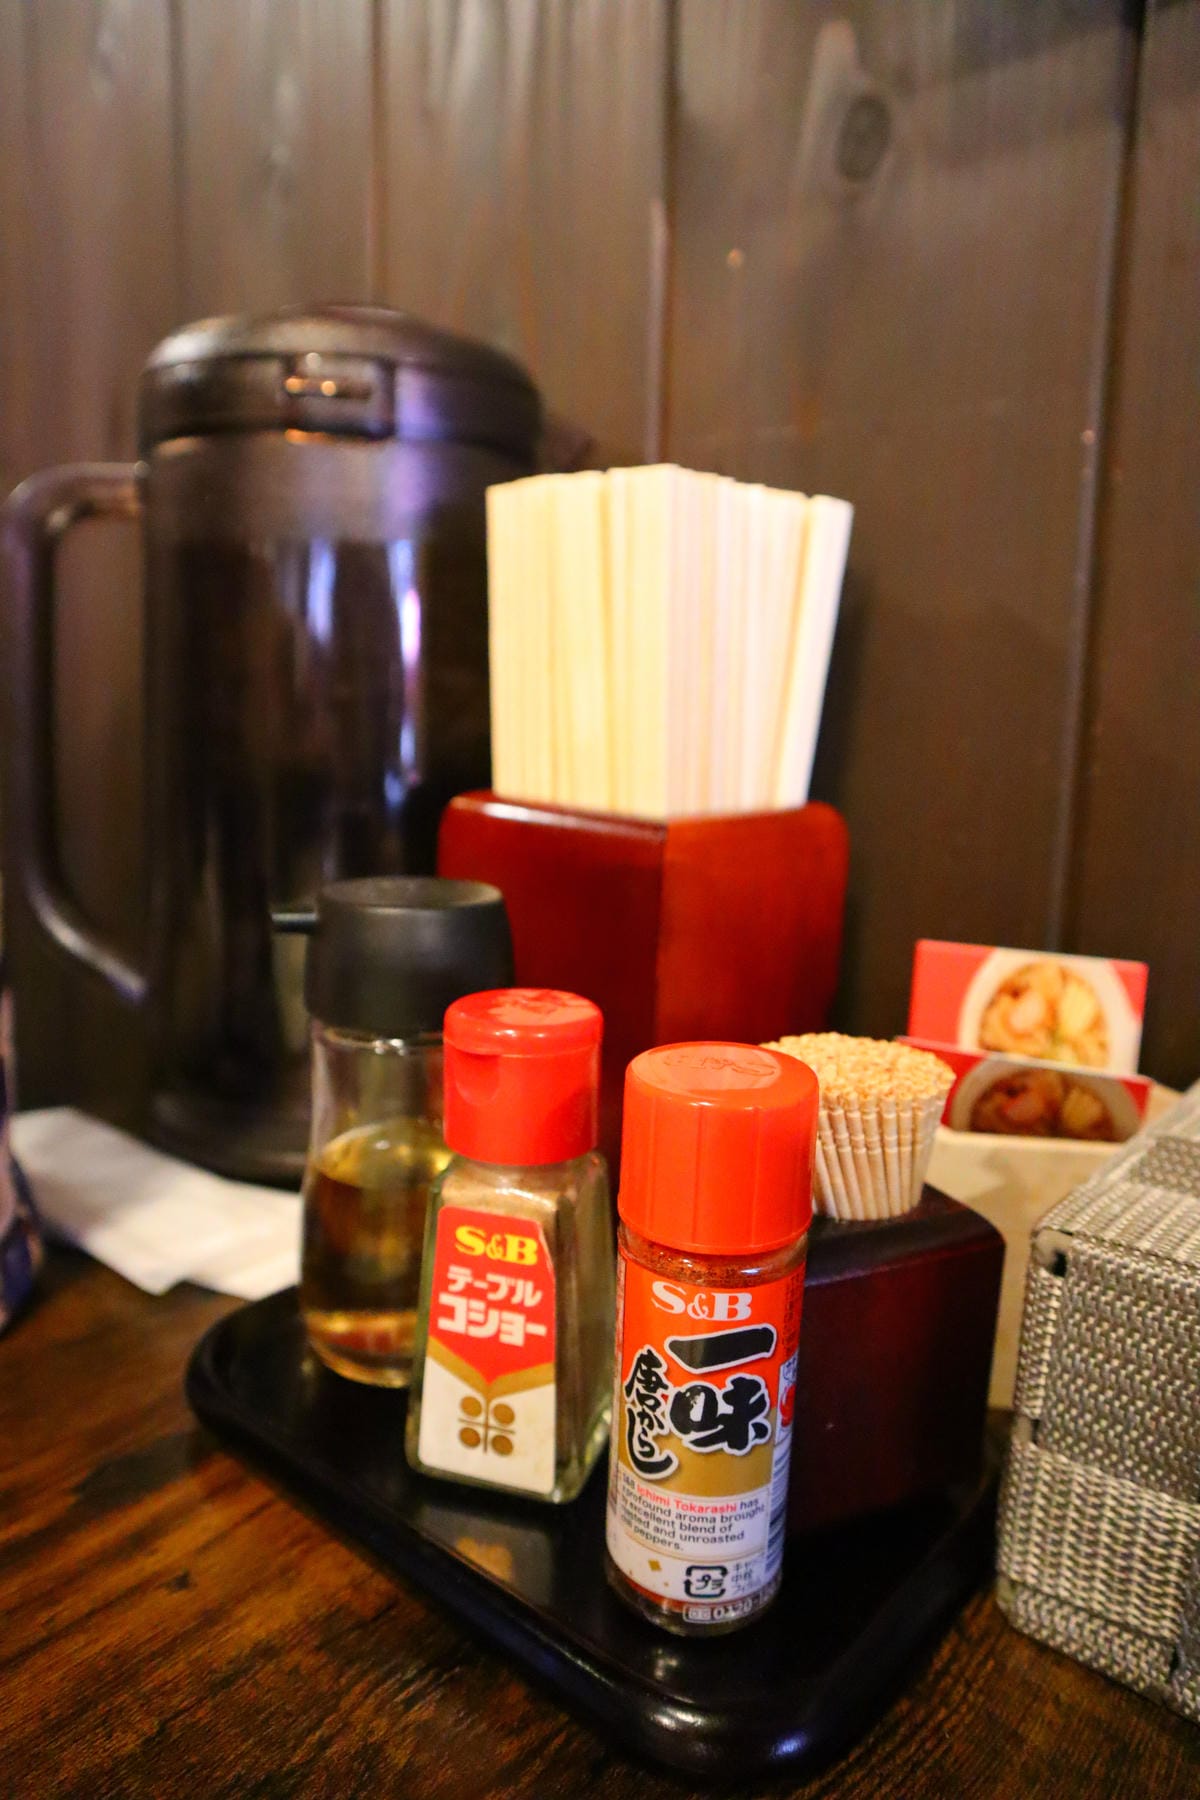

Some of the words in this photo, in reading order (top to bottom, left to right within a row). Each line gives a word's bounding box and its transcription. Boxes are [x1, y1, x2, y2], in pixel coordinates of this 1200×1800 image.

[455, 1225, 538, 1265] S&B
[447, 1265, 542, 1307] テーブル
[651, 1280, 753, 1322] S&B
[437, 1294, 547, 1347] コショー
[653, 1526, 676, 1539] and
[680, 1530, 745, 1545] unroasted
[675, 1511, 717, 1524] aroma
[680, 1522, 716, 1534] blend
[720, 1523, 733, 1533] of
